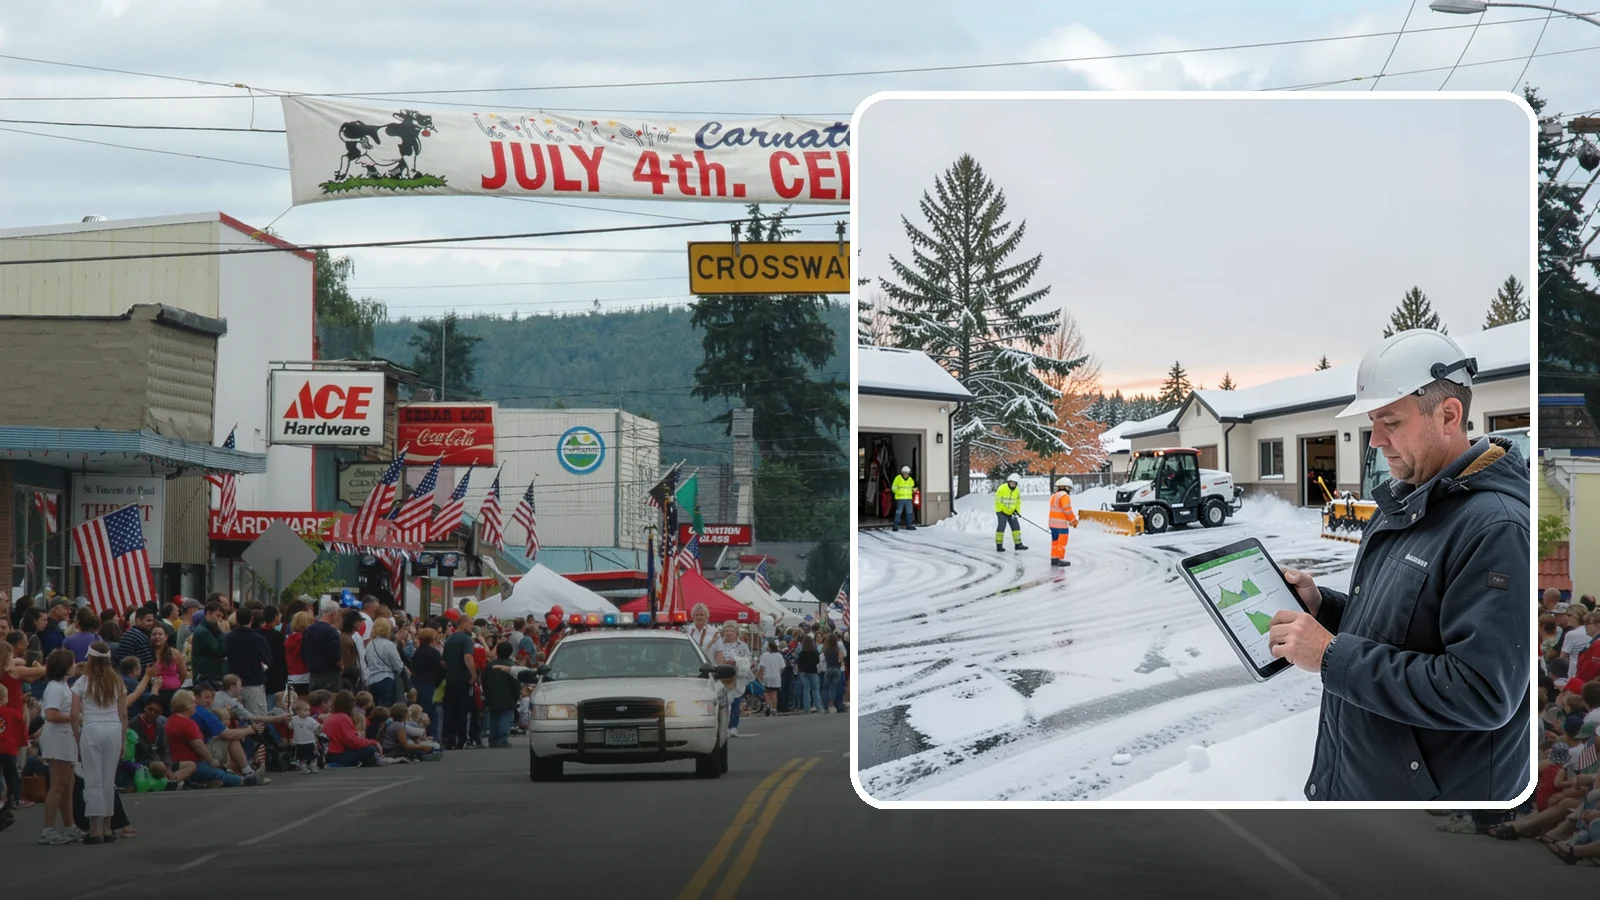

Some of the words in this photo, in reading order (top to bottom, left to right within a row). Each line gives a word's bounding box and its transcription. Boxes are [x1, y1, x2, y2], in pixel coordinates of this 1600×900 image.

[695, 121, 850, 149] Carnat
[481, 141, 605, 193] JULY
[632, 150, 746, 197] 4th.
[697, 254, 850, 279] CROSSWA
[283, 380, 373, 420] ACE
[405, 409, 452, 422] CEDAR
[461, 409, 485, 422] LOG
[283, 421, 370, 436] Hardware
[416, 428, 476, 446] Coca-Cola
[353, 467, 385, 480] Simpl
[83, 486, 93, 494] St.
[95, 485, 124, 495] Vincent
[126, 485, 136, 495] de
[137, 486, 155, 495] Paul
[688, 526, 741, 535] CRNATION
[699, 535, 730, 543] GLASS
